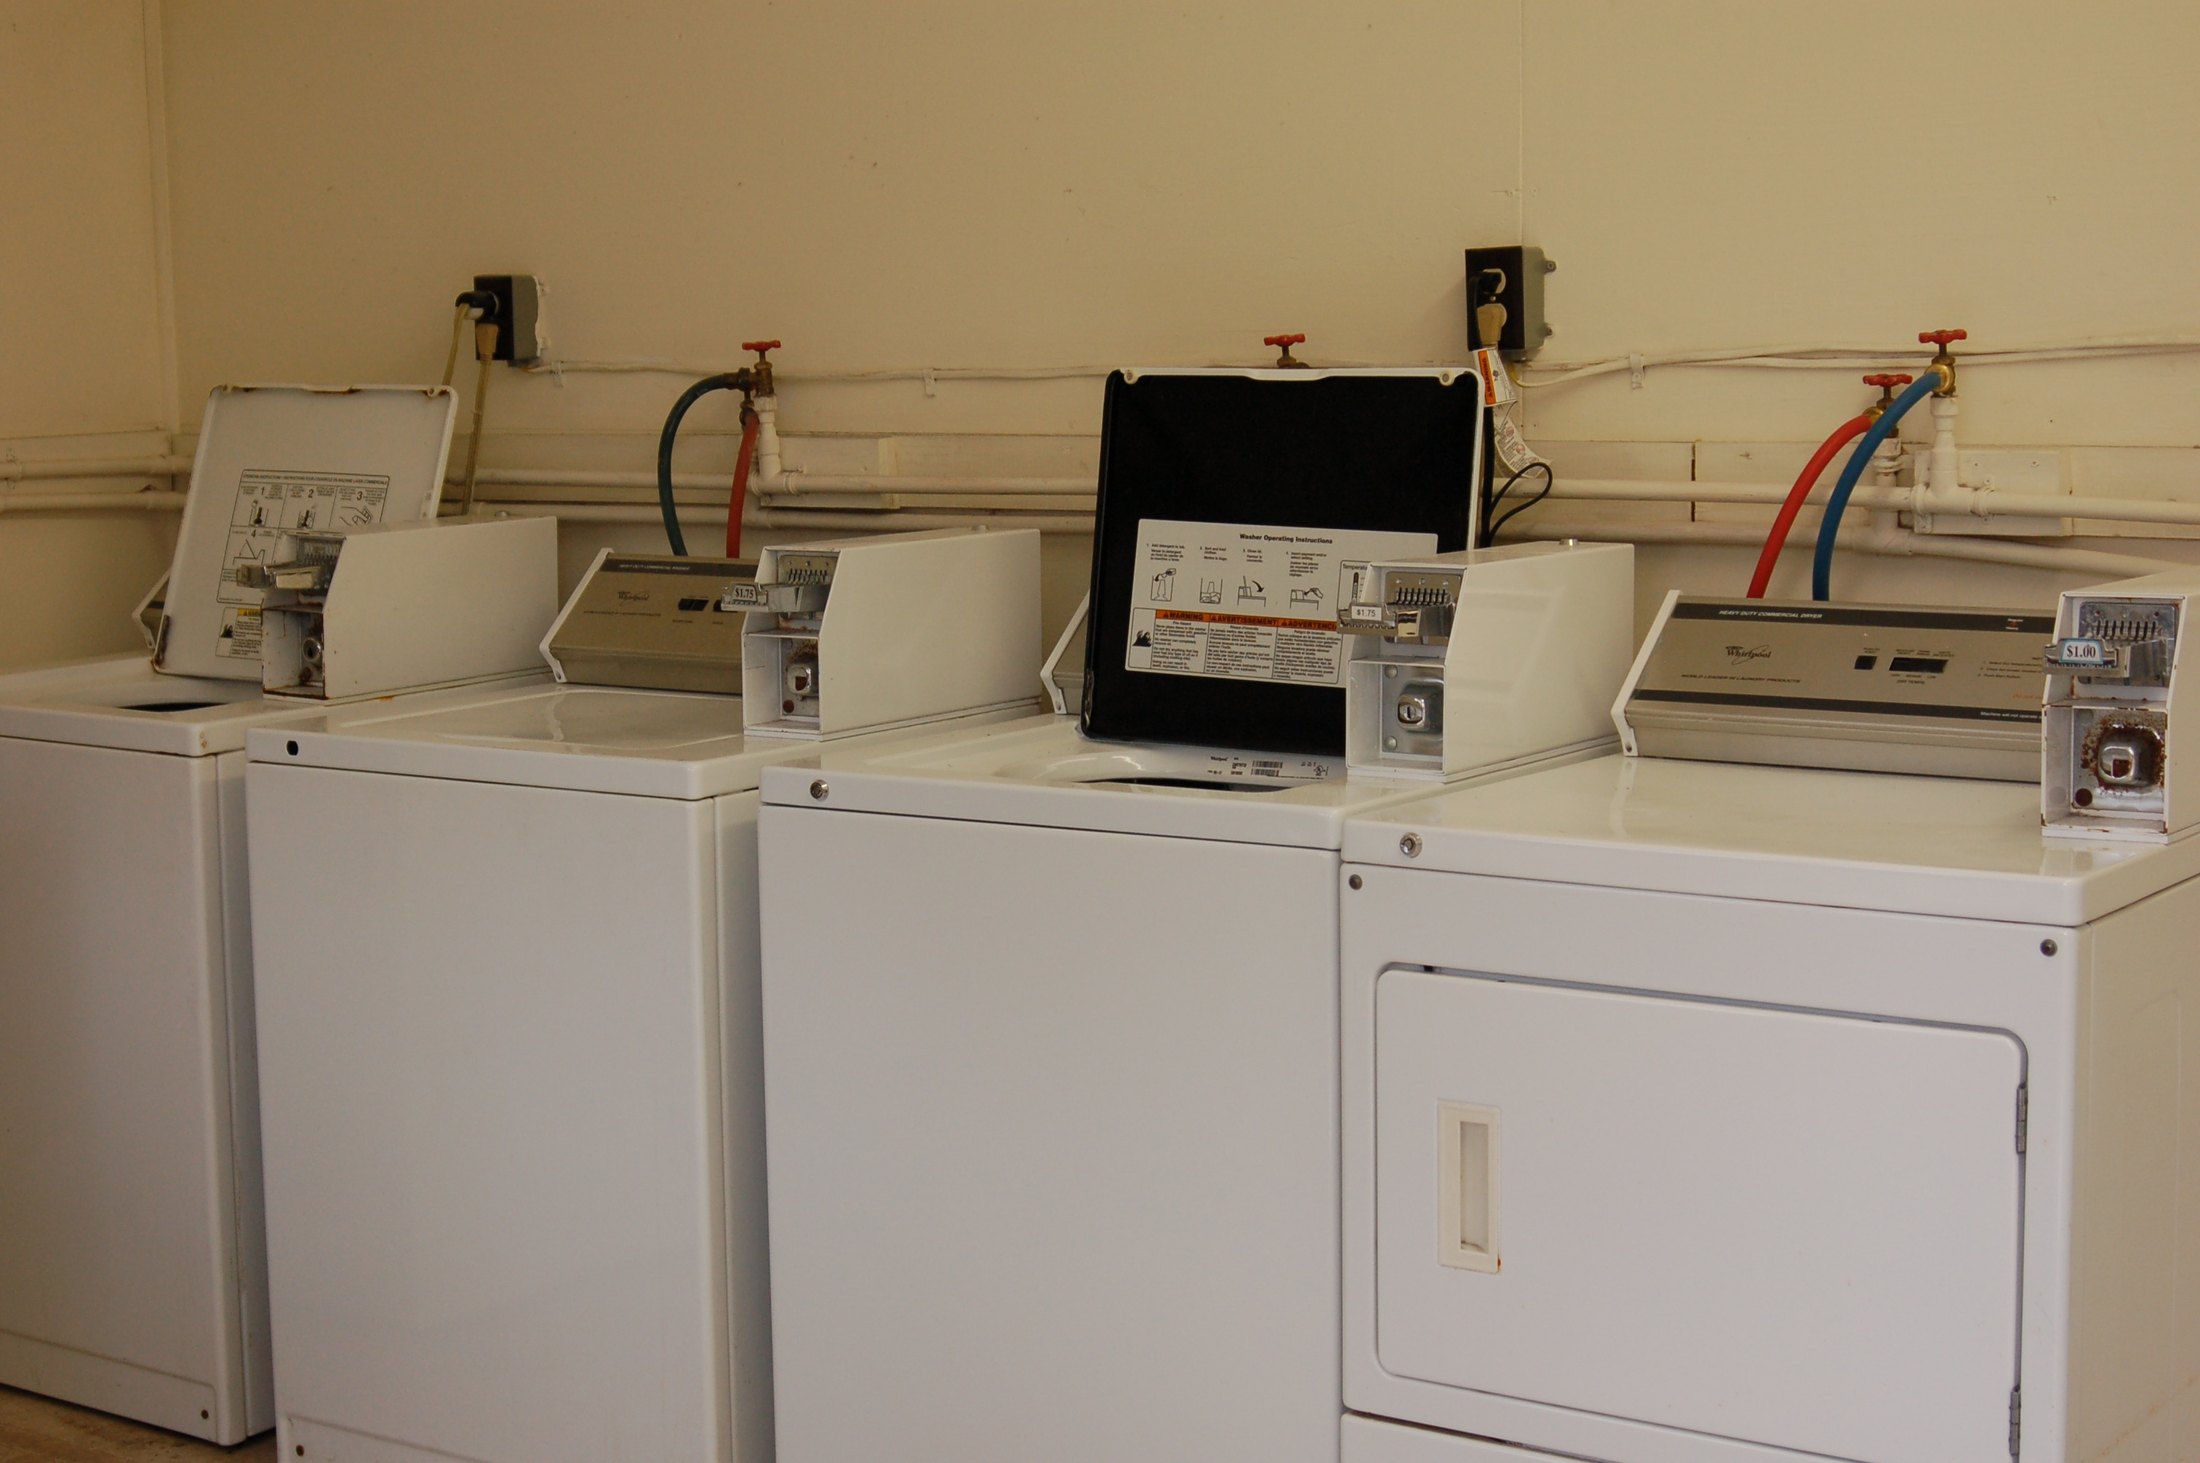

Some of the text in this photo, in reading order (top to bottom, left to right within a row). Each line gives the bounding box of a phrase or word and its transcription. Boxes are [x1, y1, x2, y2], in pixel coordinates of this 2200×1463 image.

[307, 488, 314, 498] 2
[356, 491, 363, 501] 3
[1240, 533, 1333, 544] Washer Operating Instructions
[735, 587, 754, 599] $1.75
[1168, 611, 1203, 620] WARNING
[1356, 608, 1376, 617] $1.75
[1217, 614, 1275, 626] AVERTISSEMENT
[1726, 648, 1772, 659] Whirlpool
[2066, 644, 2096, 658] $1.00
